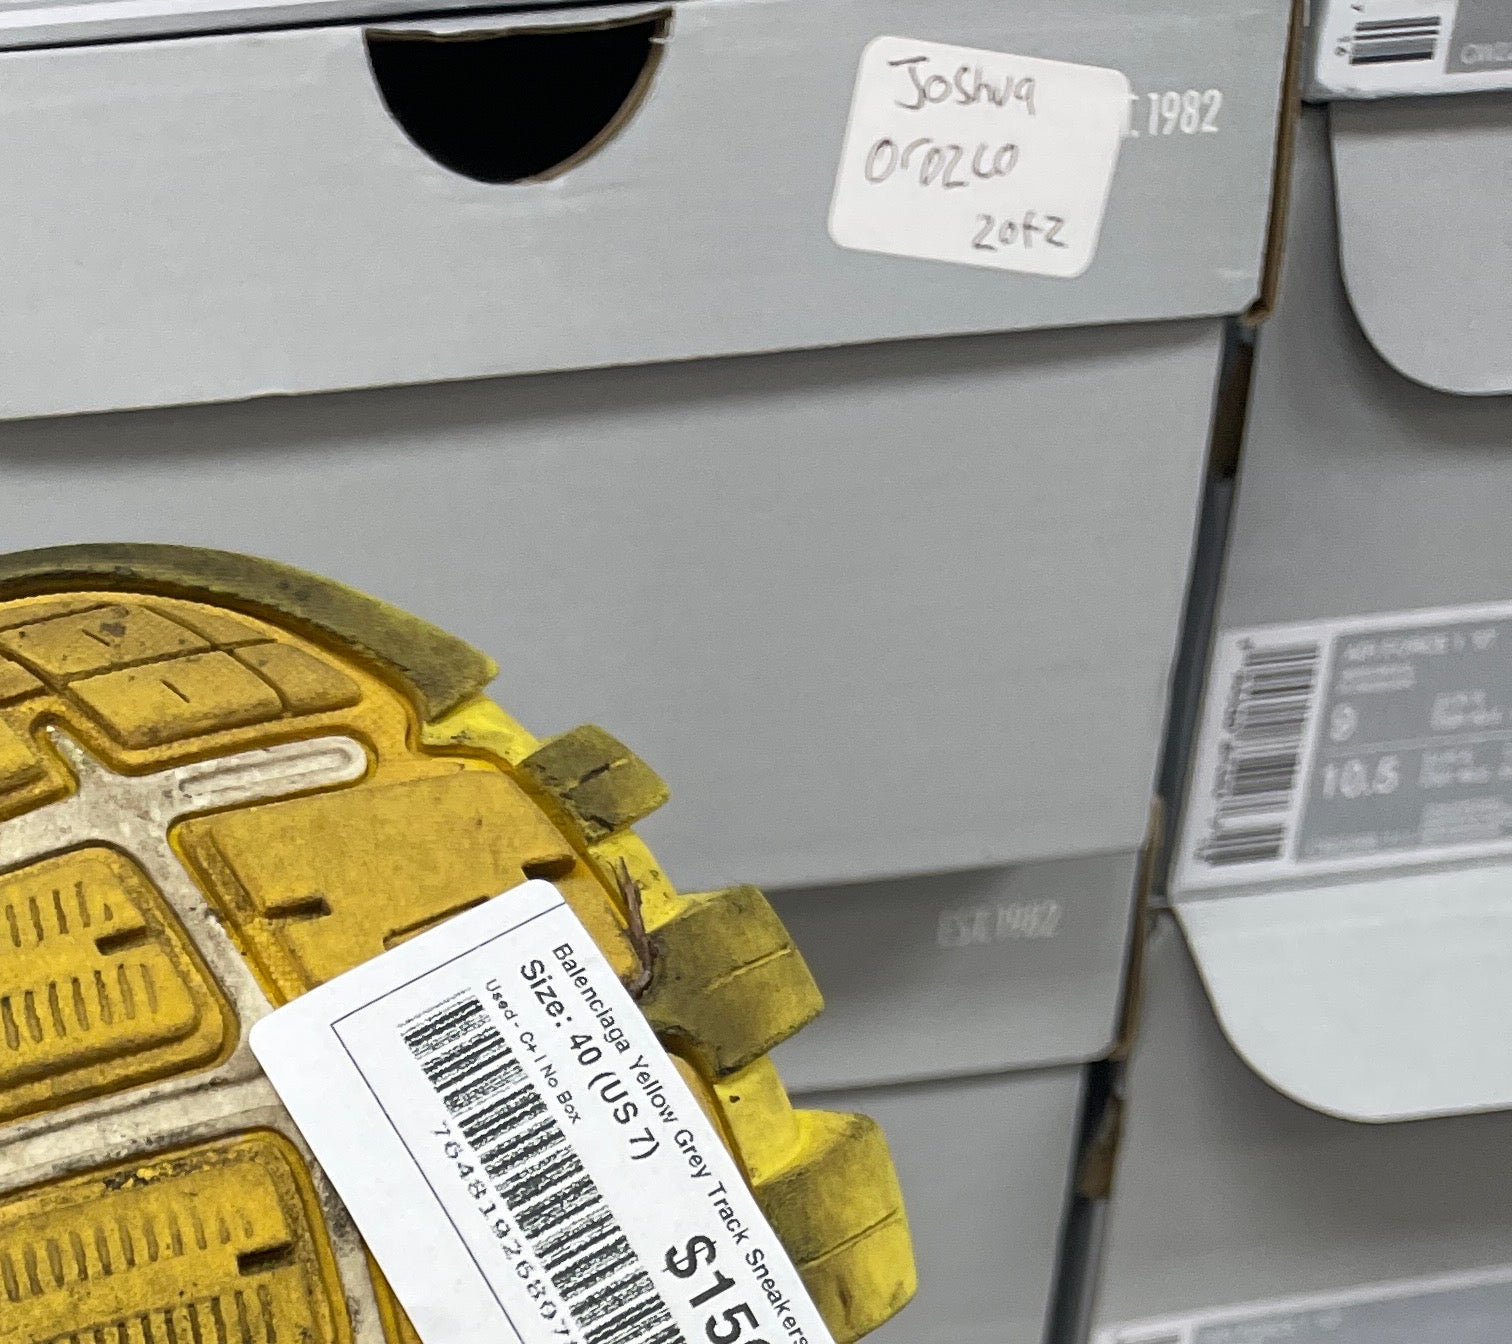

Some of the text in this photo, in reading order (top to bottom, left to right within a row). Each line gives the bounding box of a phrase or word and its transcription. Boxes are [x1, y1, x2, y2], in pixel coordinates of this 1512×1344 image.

[486, 978, 519, 1021] Used
[540, 1063, 559, 1088] No
[556, 1090, 582, 1125] Box
[520, 959, 660, 1161] Size: 40 (US 7)
[552, 943, 631, 1054] Balenciaga
[629, 1054, 678, 1124] Yellow
[674, 1129, 712, 1179] Grey
[707, 1181, 750, 1245] Track
